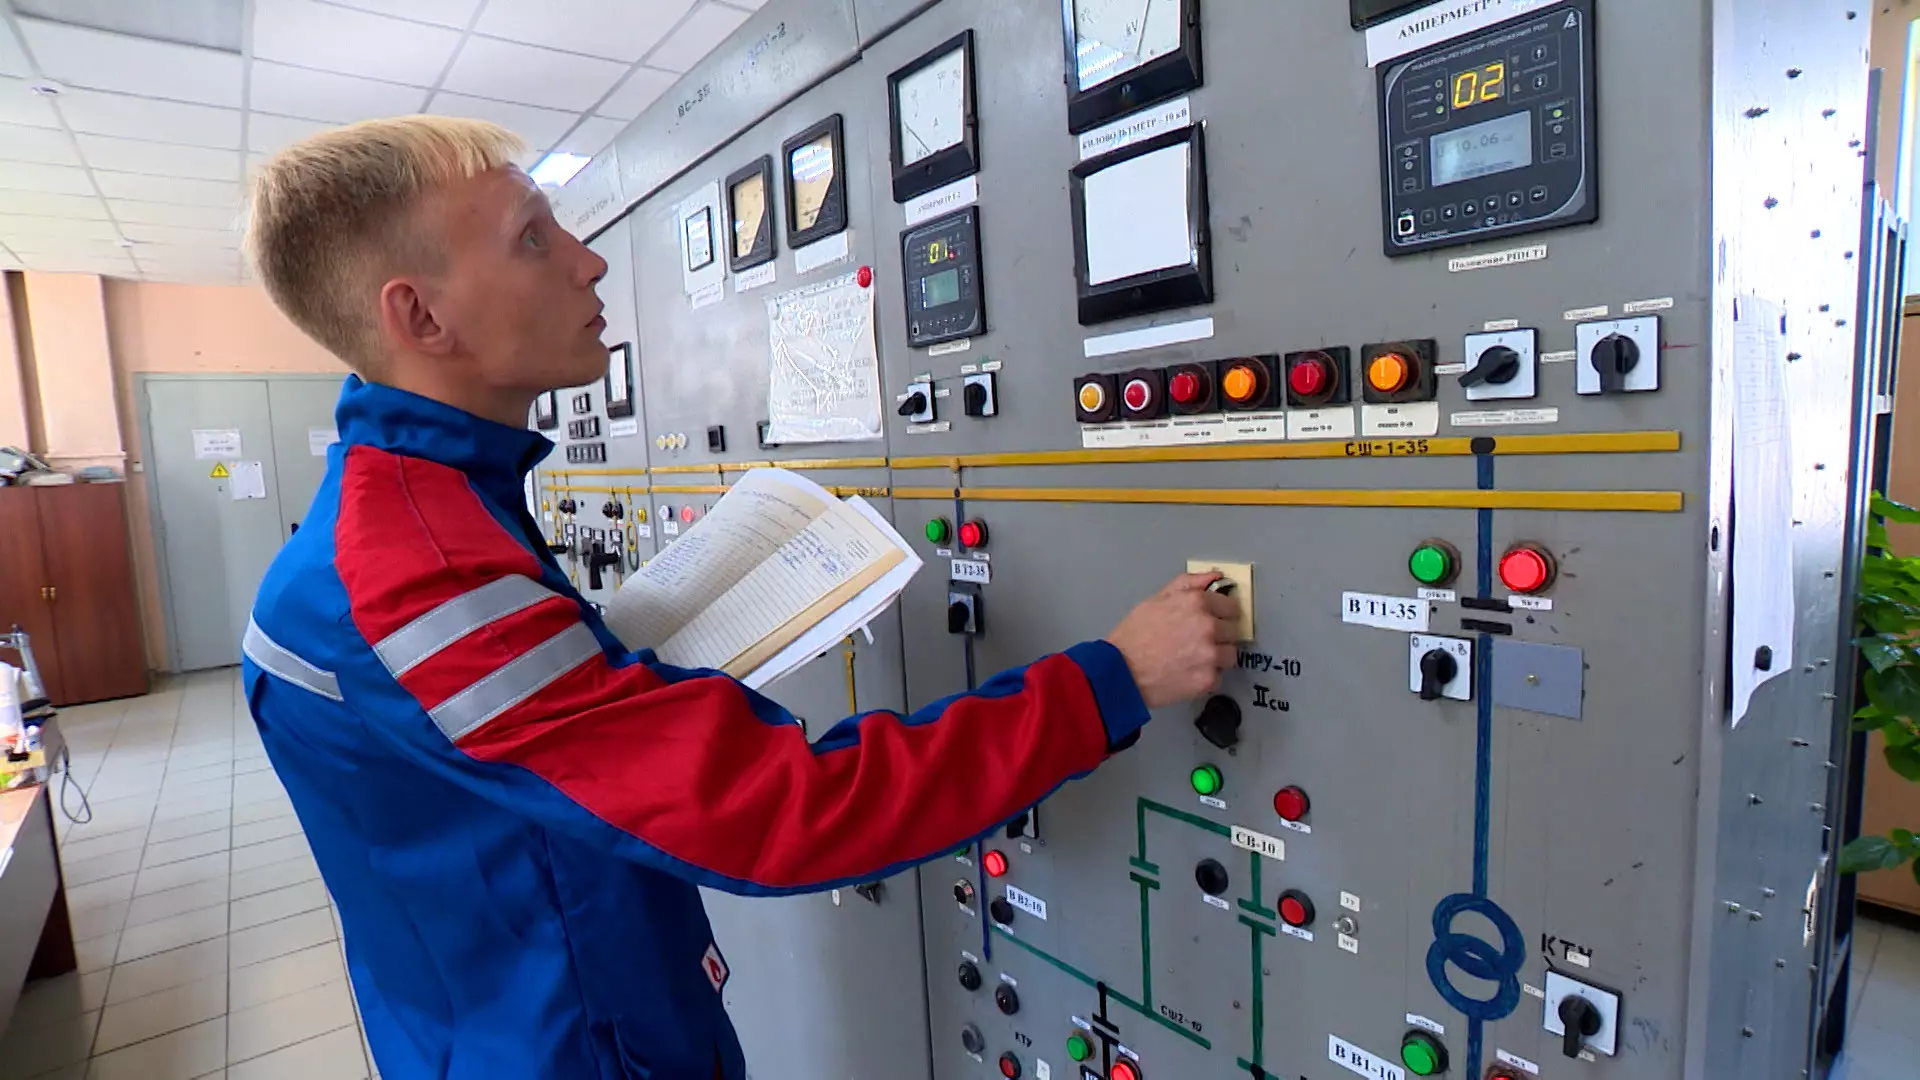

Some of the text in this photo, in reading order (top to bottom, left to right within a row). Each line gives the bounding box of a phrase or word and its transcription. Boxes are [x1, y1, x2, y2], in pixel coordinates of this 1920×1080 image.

[1453, 63, 1504, 109] 02
[1165, 112, 1175, 124] 10
[929, 242, 948, 264] 01
[1344, 439, 1429, 457] СШ-1-35
[953, 563, 962, 575] В
[1347, 598, 1418, 620] В Т1-35
[1235, 831, 1276, 855] СВ-10
[1009, 889, 1042, 914] В В2-10
[1335, 1043, 1397, 1080] В В1-10
